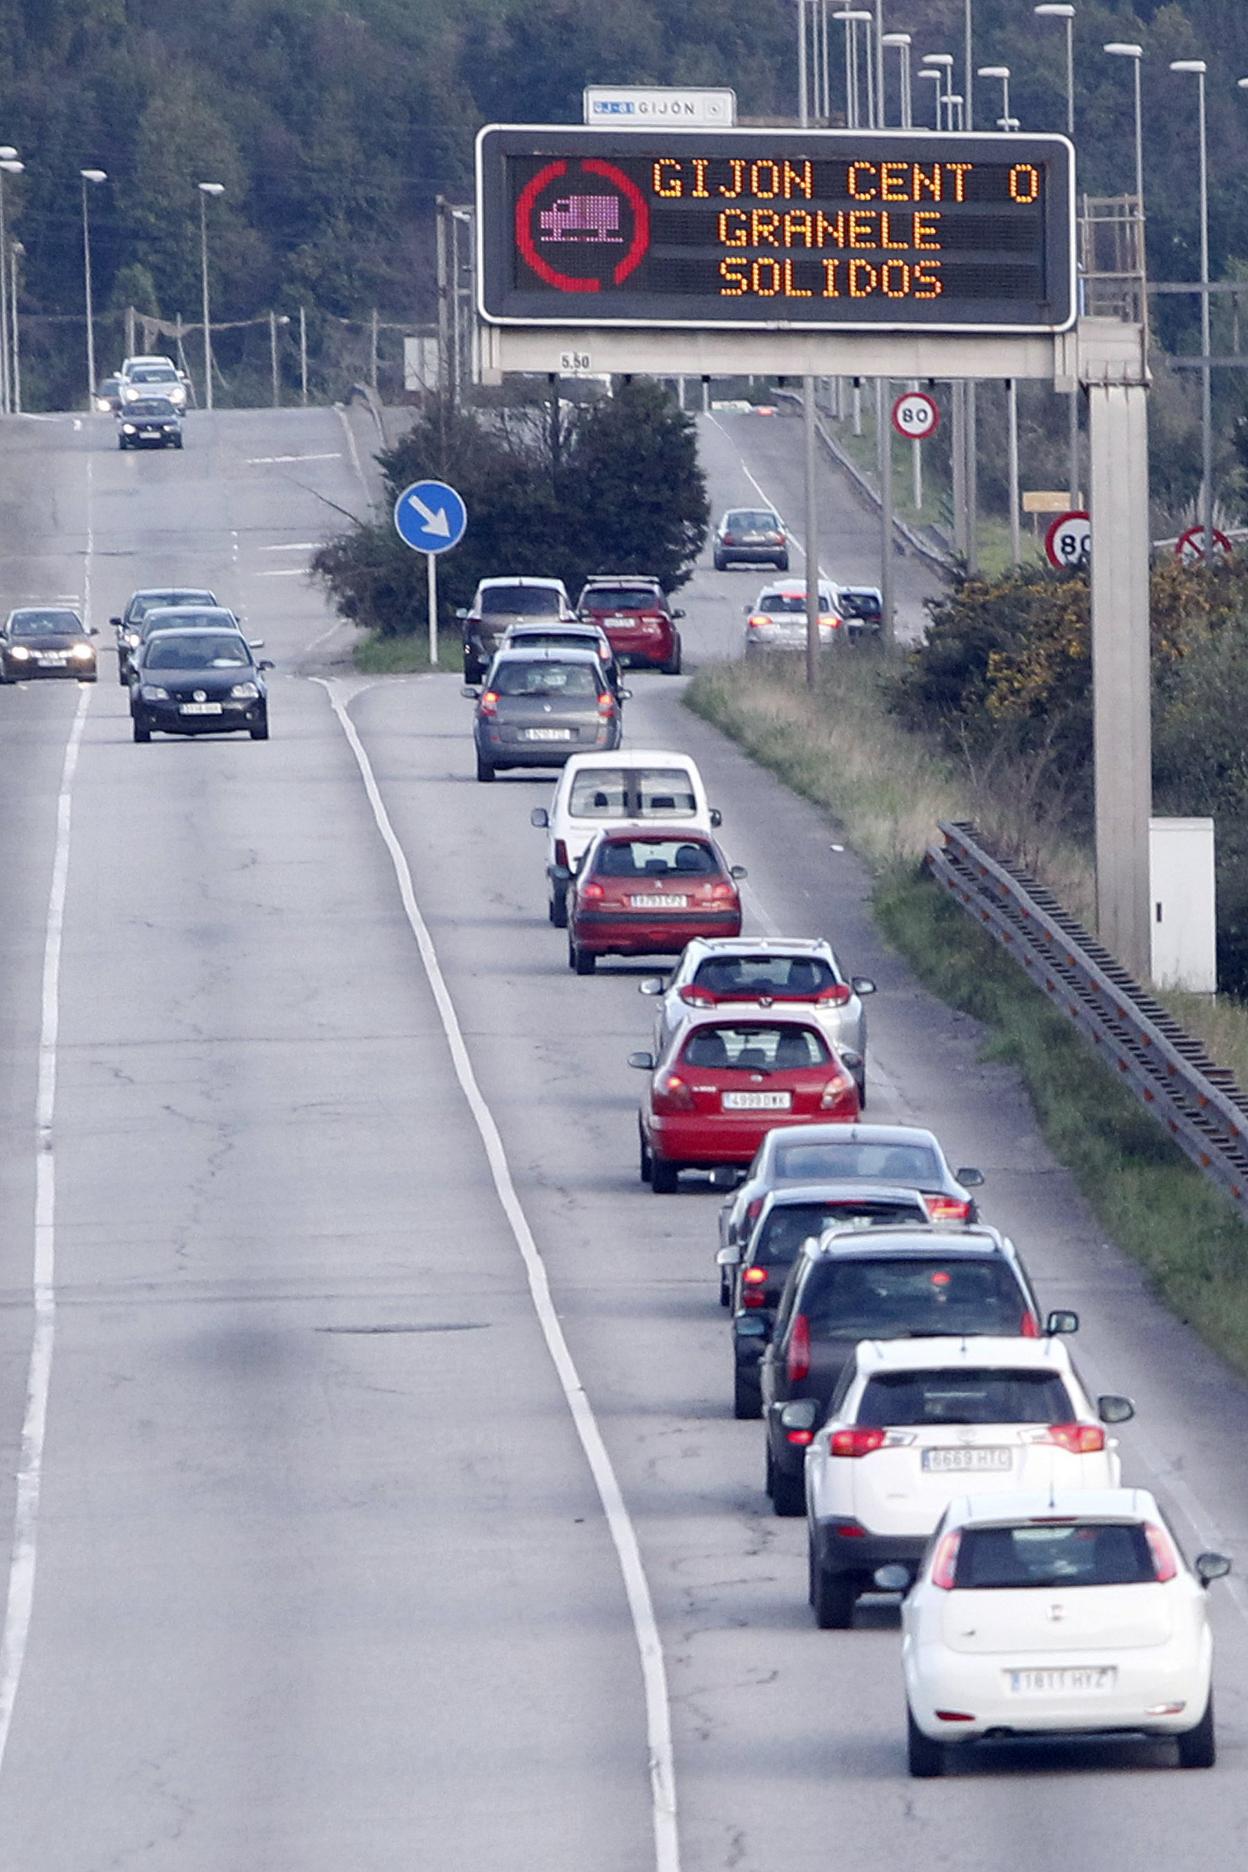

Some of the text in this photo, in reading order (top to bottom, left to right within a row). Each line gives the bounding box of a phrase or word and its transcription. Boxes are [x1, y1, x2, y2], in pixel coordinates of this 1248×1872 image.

[638, 102, 695, 115] GIJÓN
[653, 158, 813, 200] GIJON
[847, 160, 974, 202] CENT
[718, 208, 943, 249] GRANELE
[719, 257, 943, 298] SOLIDOS
[561, 354, 590, 369] 5.50
[902, 407, 929, 423] 80
[1061, 534, 1091, 556] 80
